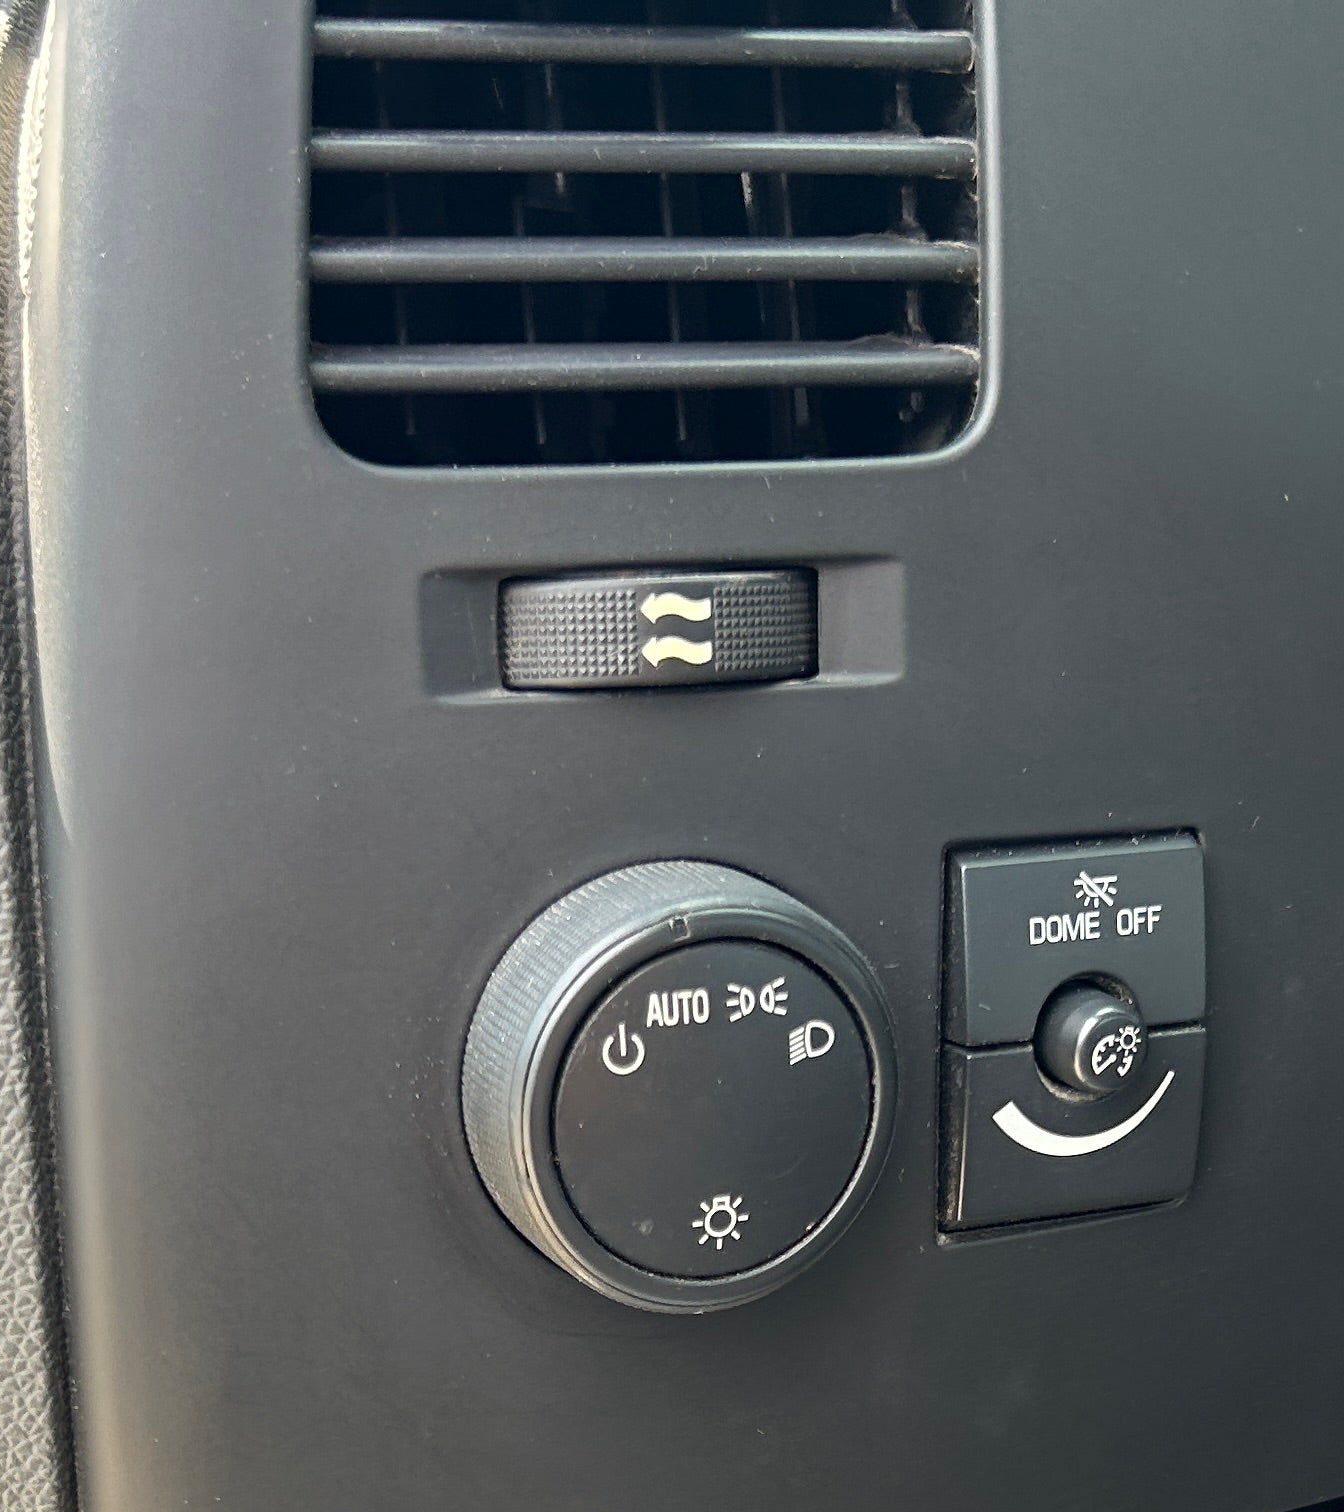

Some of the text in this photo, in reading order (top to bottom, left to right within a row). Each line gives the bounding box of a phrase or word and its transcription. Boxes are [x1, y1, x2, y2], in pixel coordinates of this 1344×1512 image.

[1029, 904, 1163, 945] DOME OFF
[646, 987, 710, 1028] AUTO
